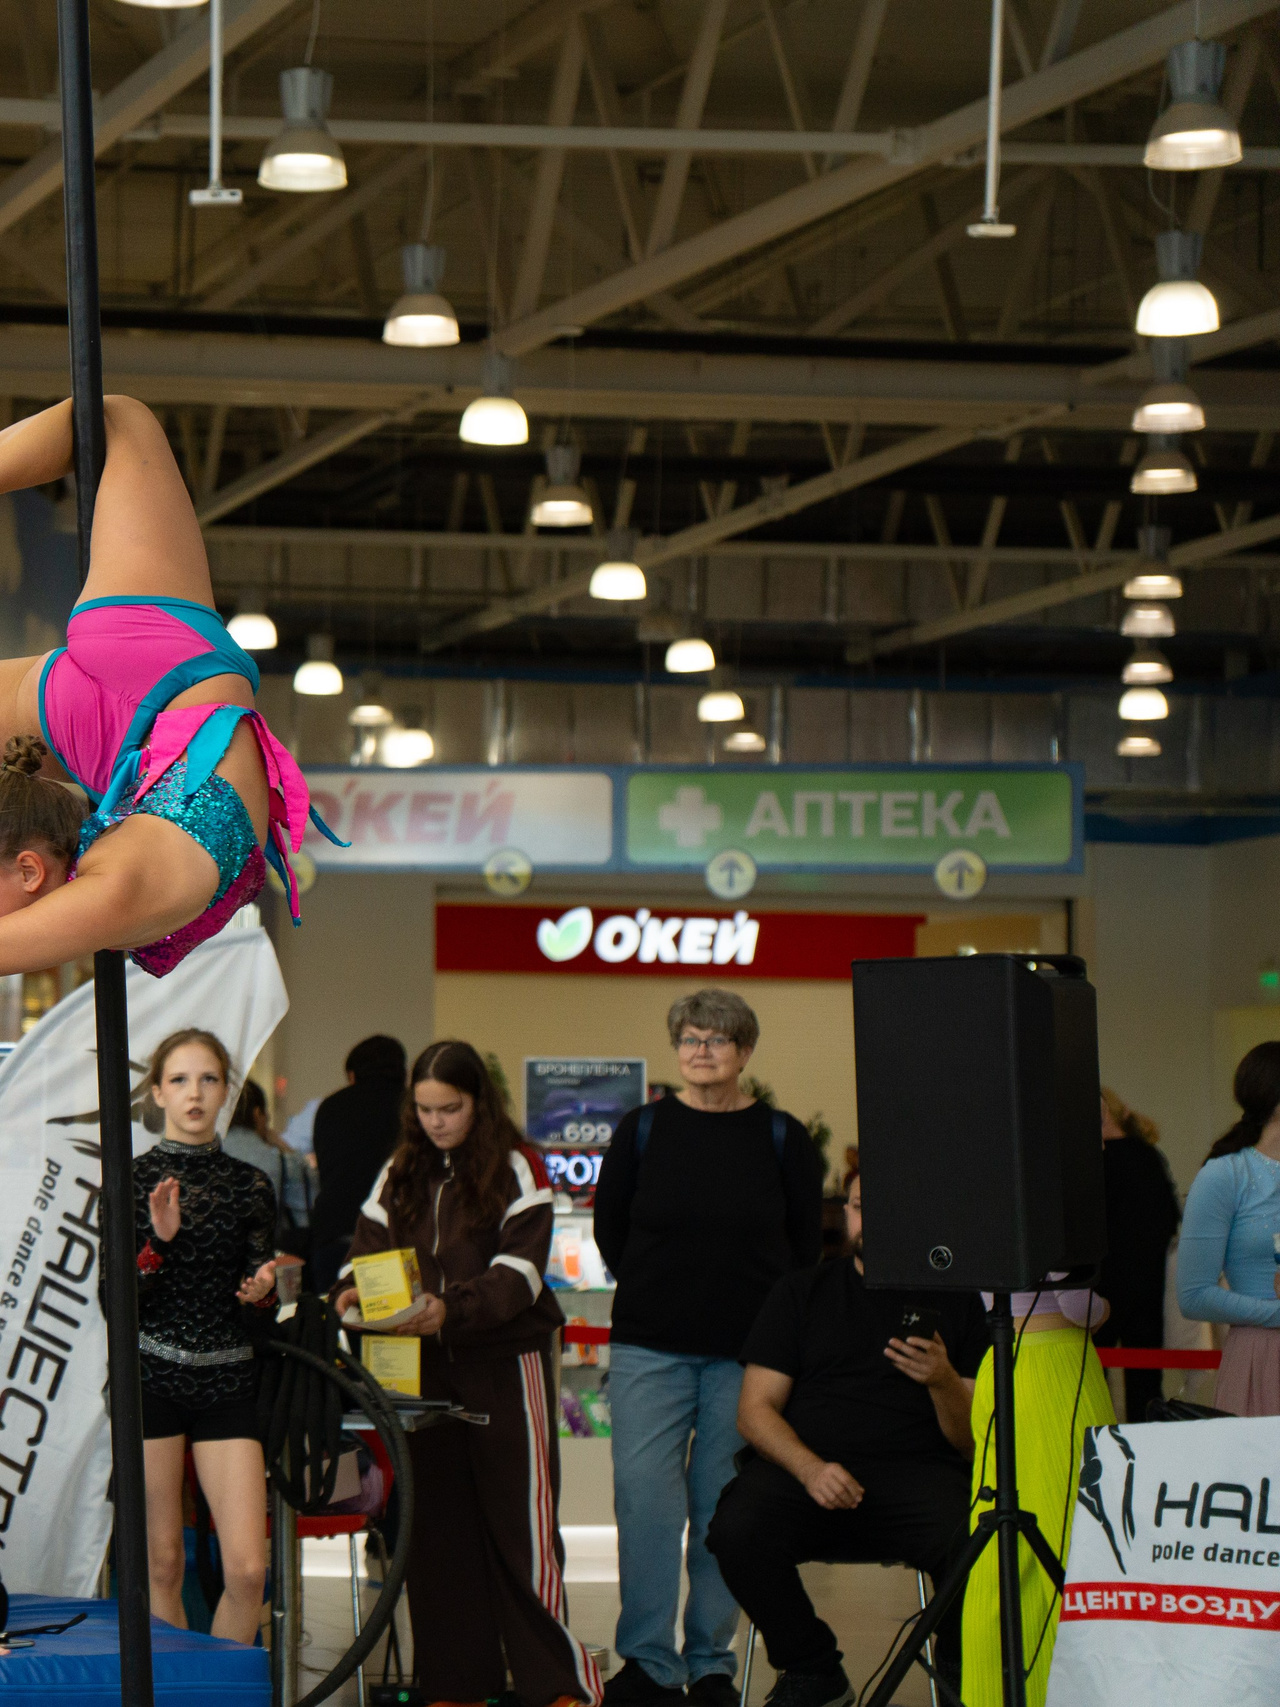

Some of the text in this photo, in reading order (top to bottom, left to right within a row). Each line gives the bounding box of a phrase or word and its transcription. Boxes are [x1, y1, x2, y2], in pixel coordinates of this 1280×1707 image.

[745, 790, 1012, 838] АПТЕКА
[564, 1122, 613, 1143] 699
[33, 1157, 63, 1212] pole
[7, 1216, 43, 1288] dance
[1152, 1541, 1280, 1567] pole dance
[1064, 1590, 1280, 1622] ЦЕНТР ВОЗДУ
